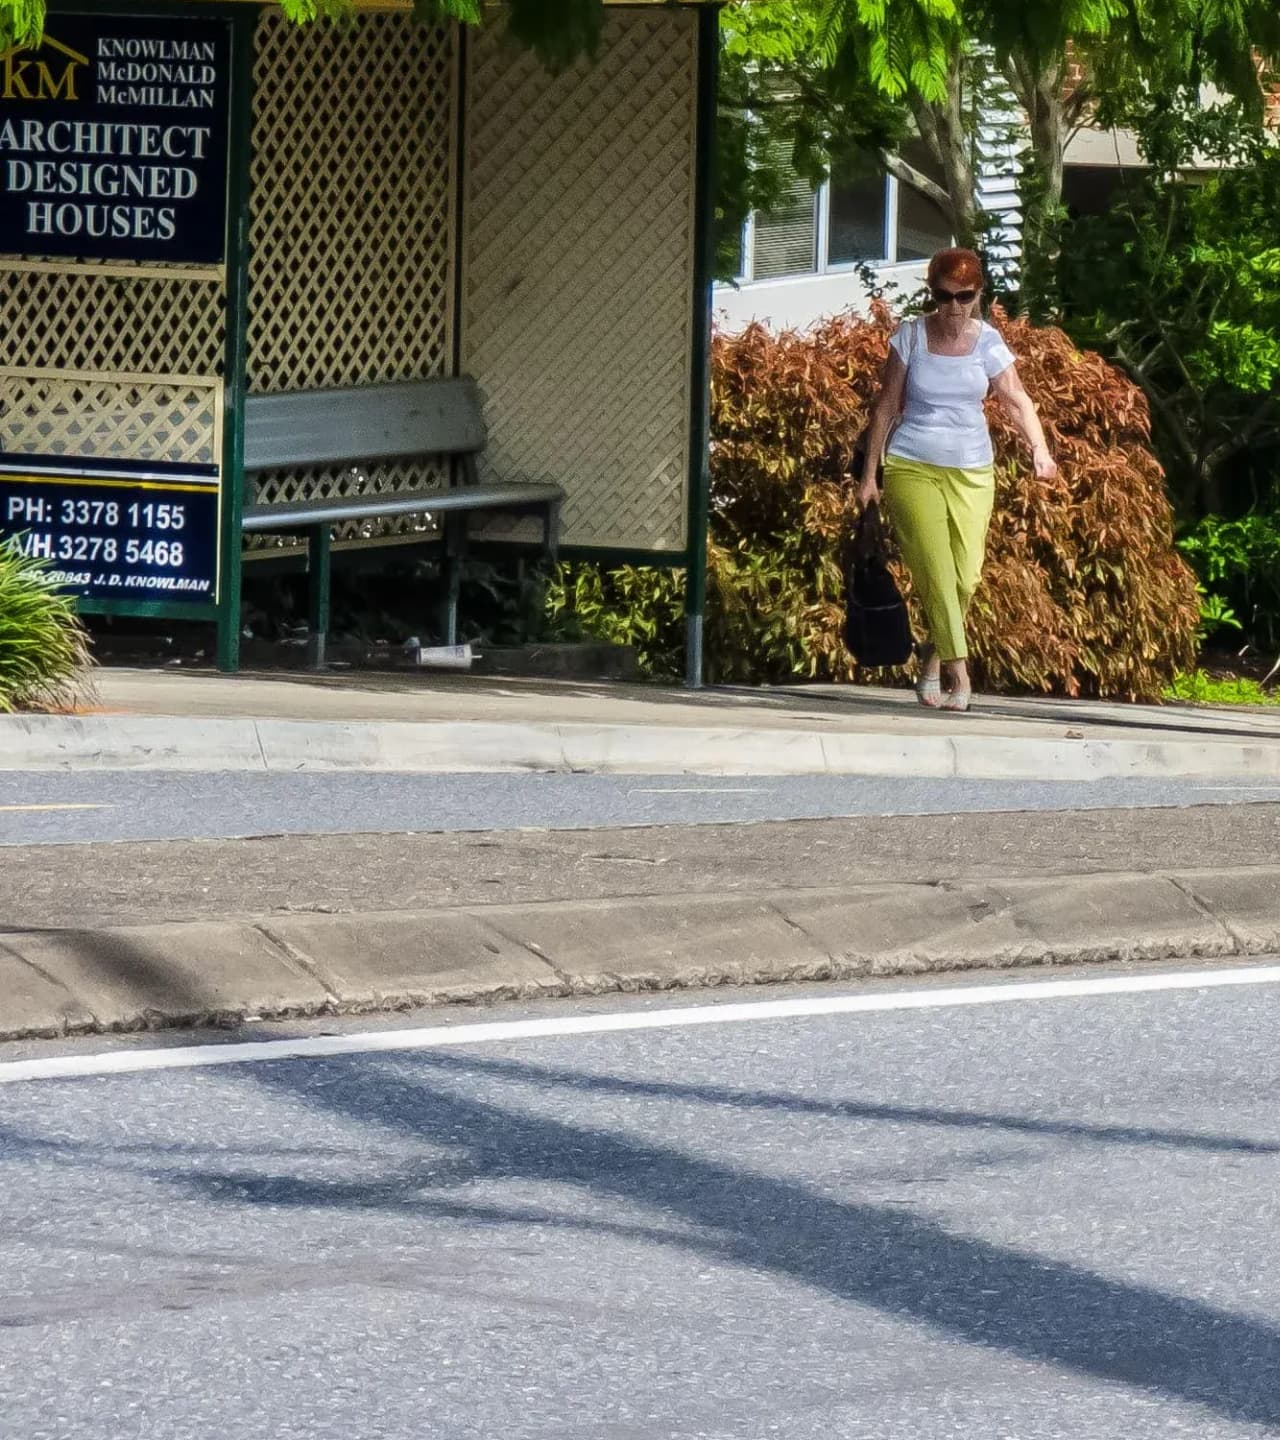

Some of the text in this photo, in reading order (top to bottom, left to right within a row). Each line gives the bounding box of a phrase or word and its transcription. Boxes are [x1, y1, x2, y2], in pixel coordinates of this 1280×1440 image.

[96, 37, 216, 61] KNOWLMAN
[1, 60, 81, 101] KM
[96, 61, 217, 85] McDONALD
[96, 85, 216, 109] McMILLAN
[0, 117, 211, 160] ARCHITECT
[6, 159, 199, 200] DESIGNED
[26, 201, 177, 241] HOUSES
[7, 496, 186, 530] PH: 3378 1155
[125, 539, 184, 567] 5468
[124, 575, 210, 592] KNOWLMAN
